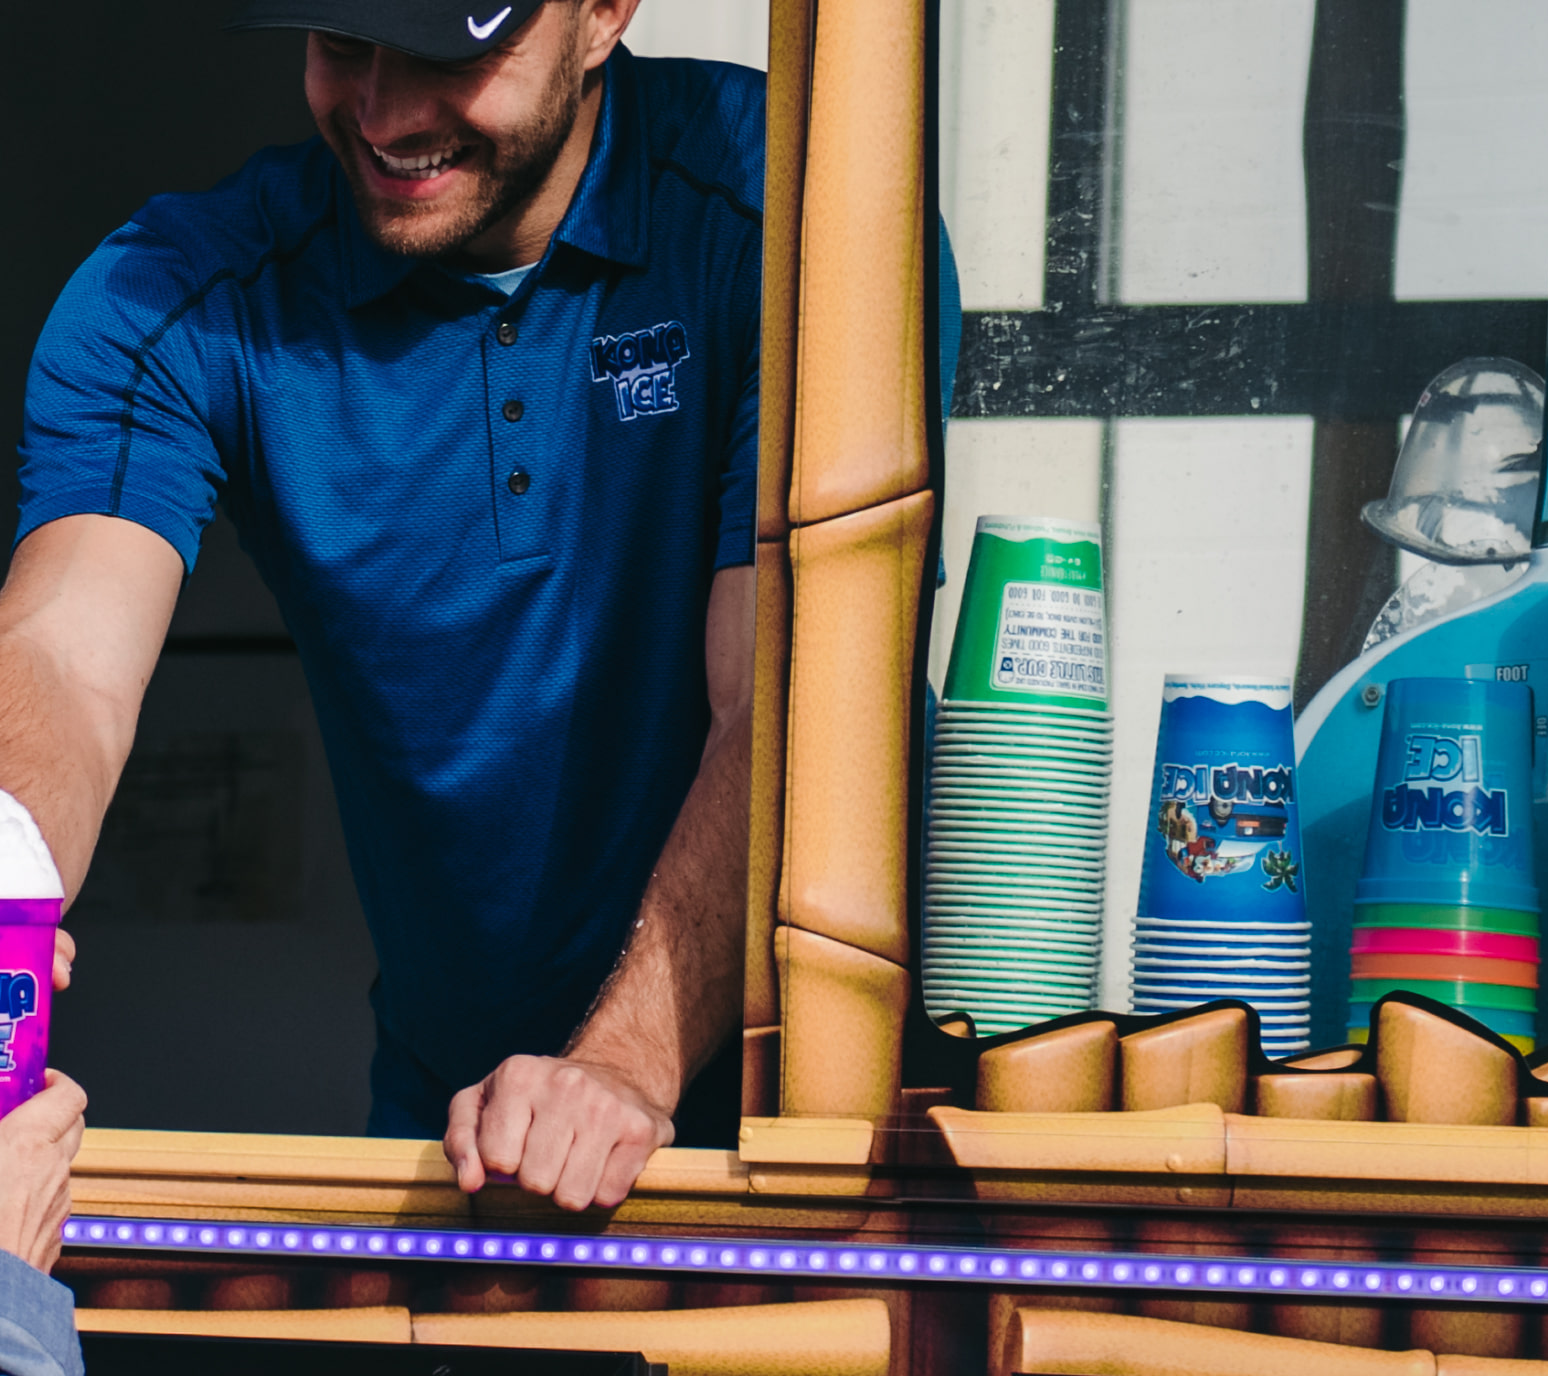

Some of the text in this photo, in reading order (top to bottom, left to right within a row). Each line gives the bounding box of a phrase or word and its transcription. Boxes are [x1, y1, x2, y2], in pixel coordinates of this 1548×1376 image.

[589, 321, 690, 421] KONA ICE
[1403, 733, 1483, 784] ICE
[1382, 783, 1509, 838] KONA
